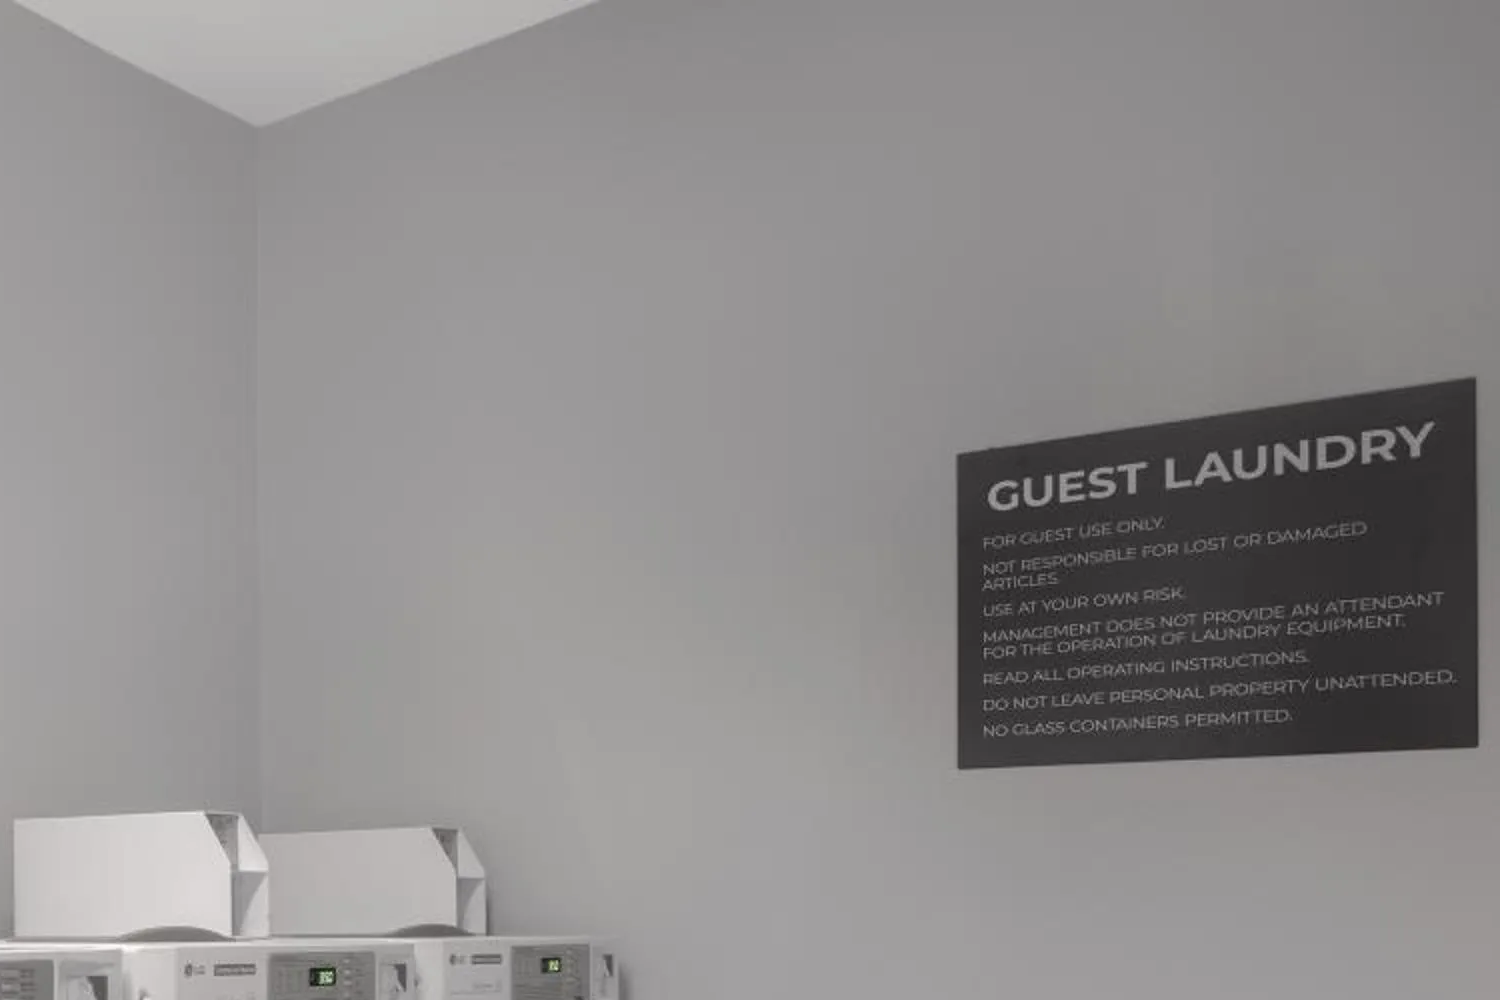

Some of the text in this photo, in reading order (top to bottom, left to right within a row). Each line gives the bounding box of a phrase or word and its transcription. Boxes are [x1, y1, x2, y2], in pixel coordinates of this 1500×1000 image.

[987, 420, 1436, 512] GUEST LAUNDRY
[982, 520, 1368, 576] NOT RESPONSIBLE FOR LOST OR DAMAGED
[983, 533, 1016, 550] FOR
[1019, 526, 1075, 546] GUEST
[1078, 521, 1113, 539] USE
[983, 602, 1014, 617] USE
[1018, 599, 1038, 616] AT
[1042, 596, 1090, 612] YOUR
[1093, 591, 1139, 608] OWN
[983, 591, 1445, 643] MANAGEMENT DOES NOT PROVIDE AN ATTENDANT
[983, 644, 1018, 661] FOR
[1021, 640, 1055, 657] THE
[1057, 633, 1157, 654] OPERATION
[1160, 631, 1188, 646] OF
[1191, 623, 1282, 643] LAUNDRY
[983, 671, 1029, 686] READ
[1031, 667, 1065, 682] ALL
[1067, 660, 1165, 681] OPERATING
[983, 669, 1458, 712] DO NOT LEAVE PERSONAL PROPERTY UNATTENDED.
[983, 722, 1009, 738] NO
[1011, 721, 1066, 736] GLASS
[1069, 714, 1180, 734] CONTAINERS
